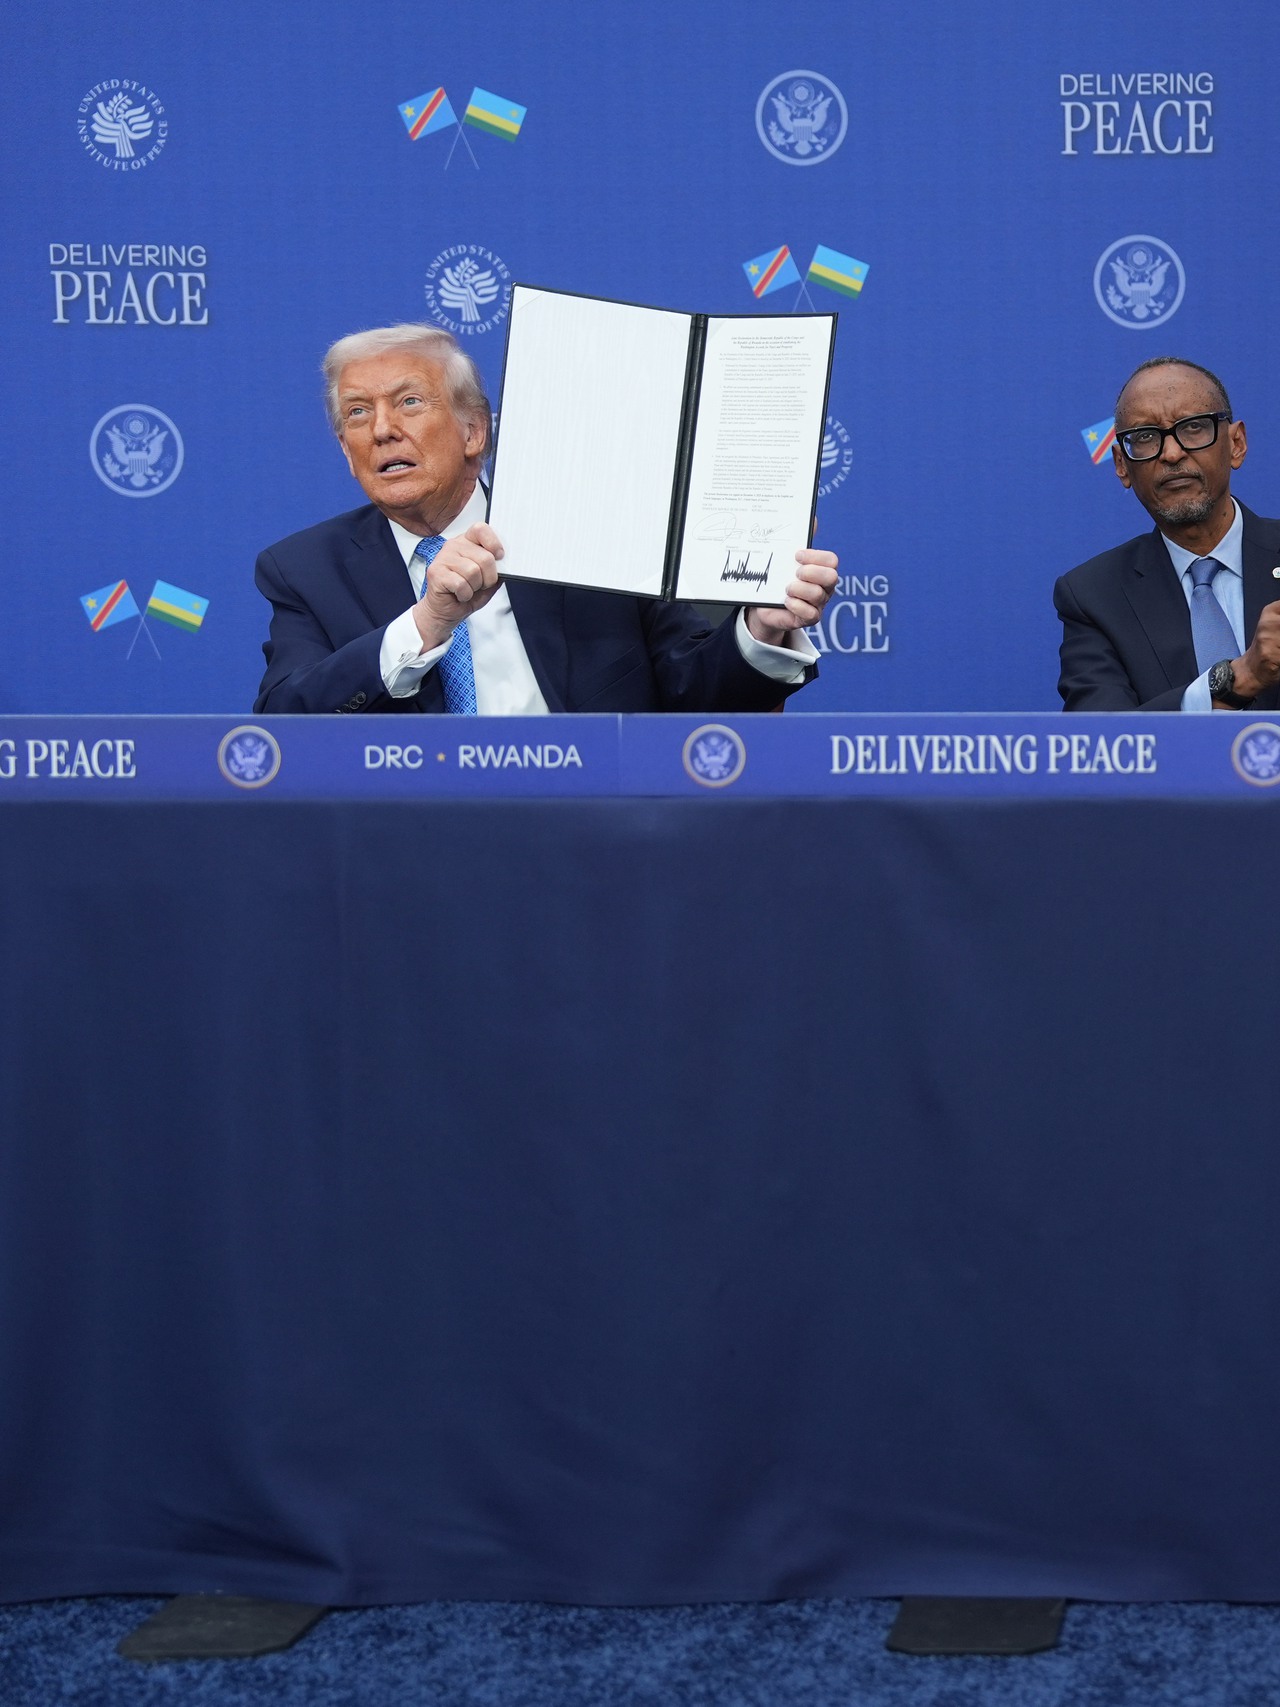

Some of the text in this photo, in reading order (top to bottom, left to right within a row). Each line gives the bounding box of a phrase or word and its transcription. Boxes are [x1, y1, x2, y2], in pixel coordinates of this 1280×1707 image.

[78, 79, 165, 115] UNITED STATES
[1059, 72, 1214, 96] DELIVERING
[77, 119, 168, 171] INSTITUTE OF PEACE
[1060, 100, 1214, 155] PEACE
[49, 243, 207, 267] DELIVERING
[425, 244, 511, 279] UNITED STATES
[51, 270, 208, 326] PEACE
[424, 284, 475, 335] INSTITUTE
[476, 321, 493, 334] OF
[831, 448, 853, 488] PEACE
[25, 739, 137, 778] PEACE
[364, 745, 583, 769] DRC RWANDA
[829, 733, 1157, 774] DELIVERING PEACE
